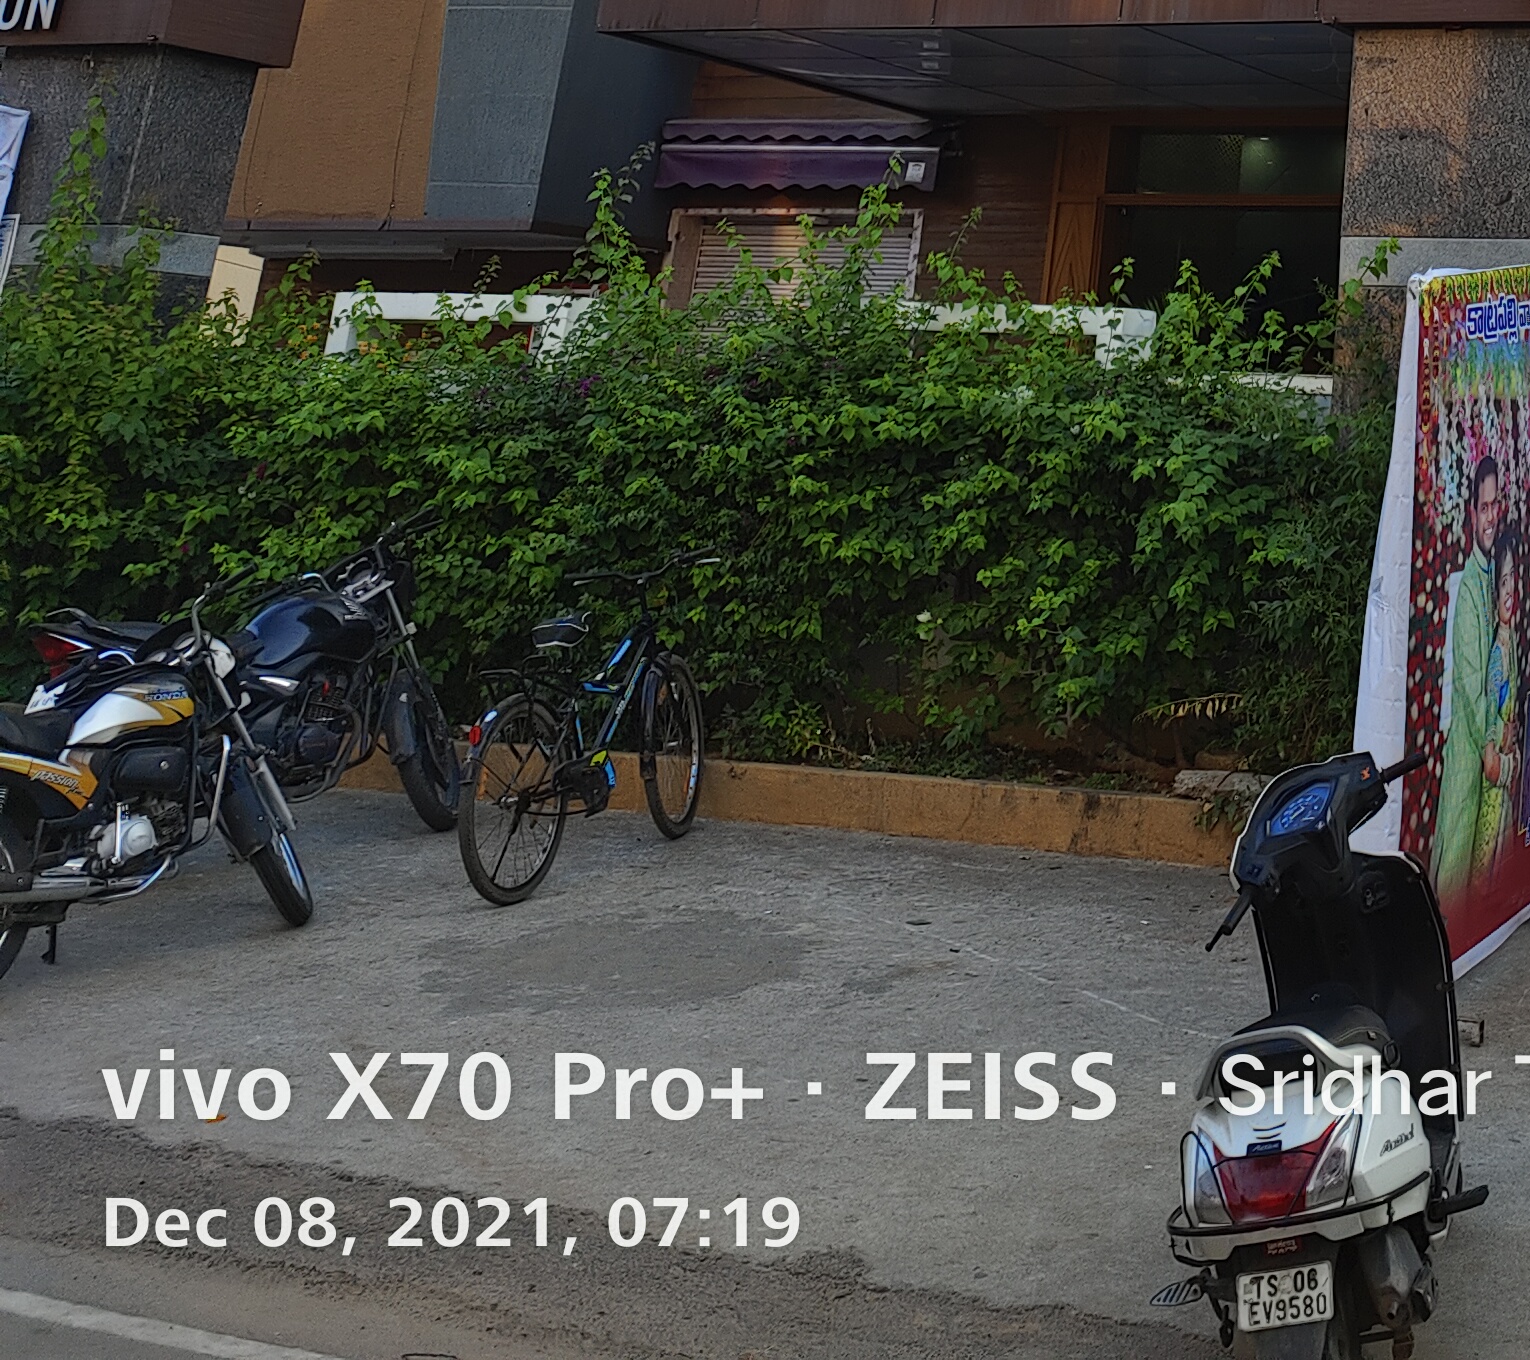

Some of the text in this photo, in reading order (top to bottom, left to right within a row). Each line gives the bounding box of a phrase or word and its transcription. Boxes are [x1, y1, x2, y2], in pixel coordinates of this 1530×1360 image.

[1249, 1268, 1318, 1300] TS 06
[1249, 1292, 1327, 1326] EV9580
